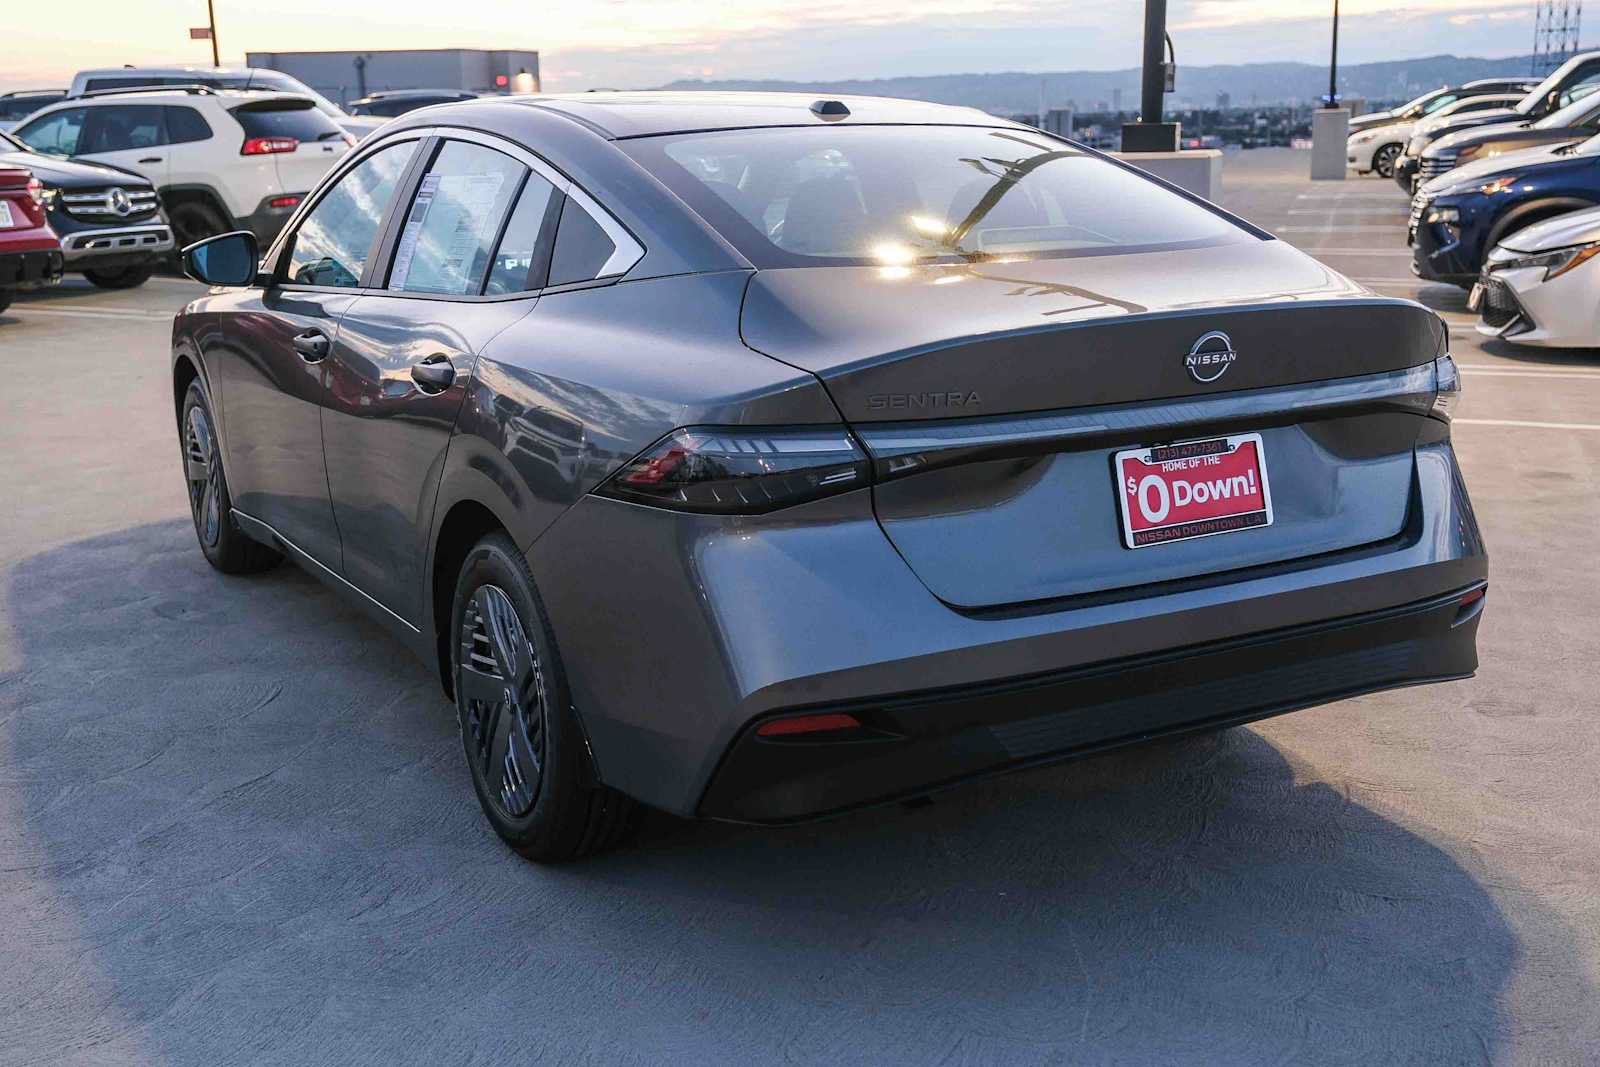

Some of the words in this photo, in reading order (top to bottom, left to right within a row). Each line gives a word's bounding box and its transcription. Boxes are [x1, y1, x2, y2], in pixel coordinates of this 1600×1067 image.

[1186, 353, 1236, 365] NISSAN
[868, 391, 983, 408] SENTRA
[1162, 459, 1188, 472] HOME
[1188, 457, 1201, 469] OF
[1203, 455, 1221, 467] THE
[1172, 469, 1257, 507] Down!
[1135, 527, 1181, 544] NISSAN
[1182, 517, 1244, 537] DOWNTOWN
